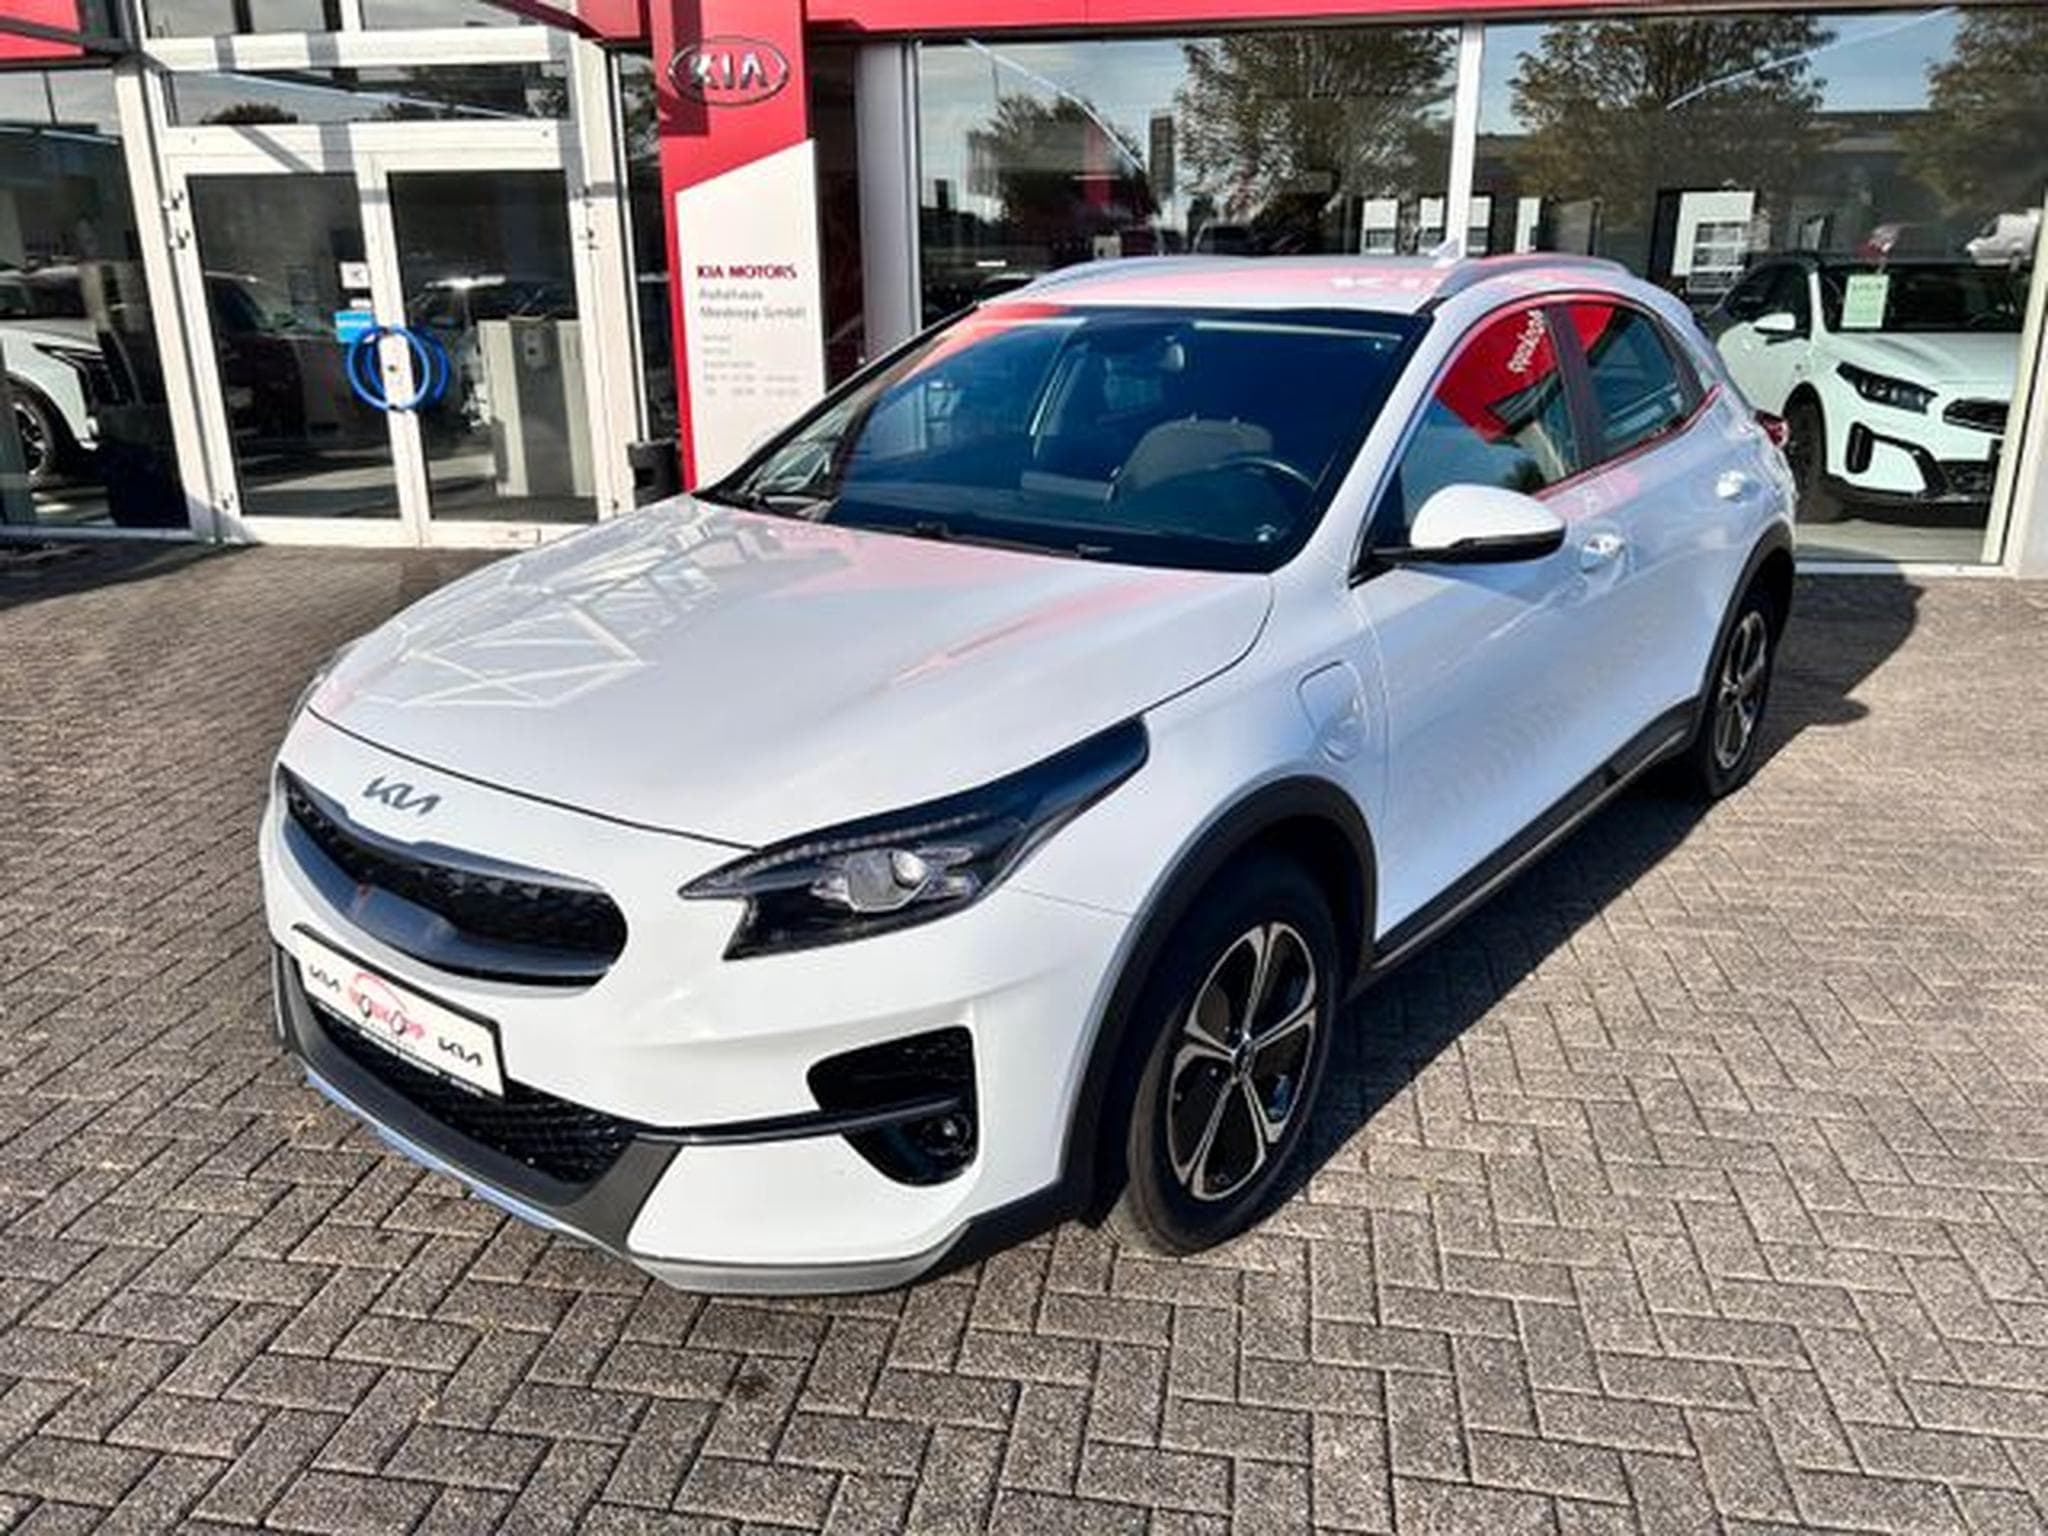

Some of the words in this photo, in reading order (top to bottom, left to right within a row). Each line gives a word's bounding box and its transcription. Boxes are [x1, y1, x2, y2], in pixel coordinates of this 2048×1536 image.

[690, 51, 769, 90] KIA
[697, 264, 724, 279] KIA
[728, 263, 798, 280] MOTORS
[362, 775, 442, 818] KIA
